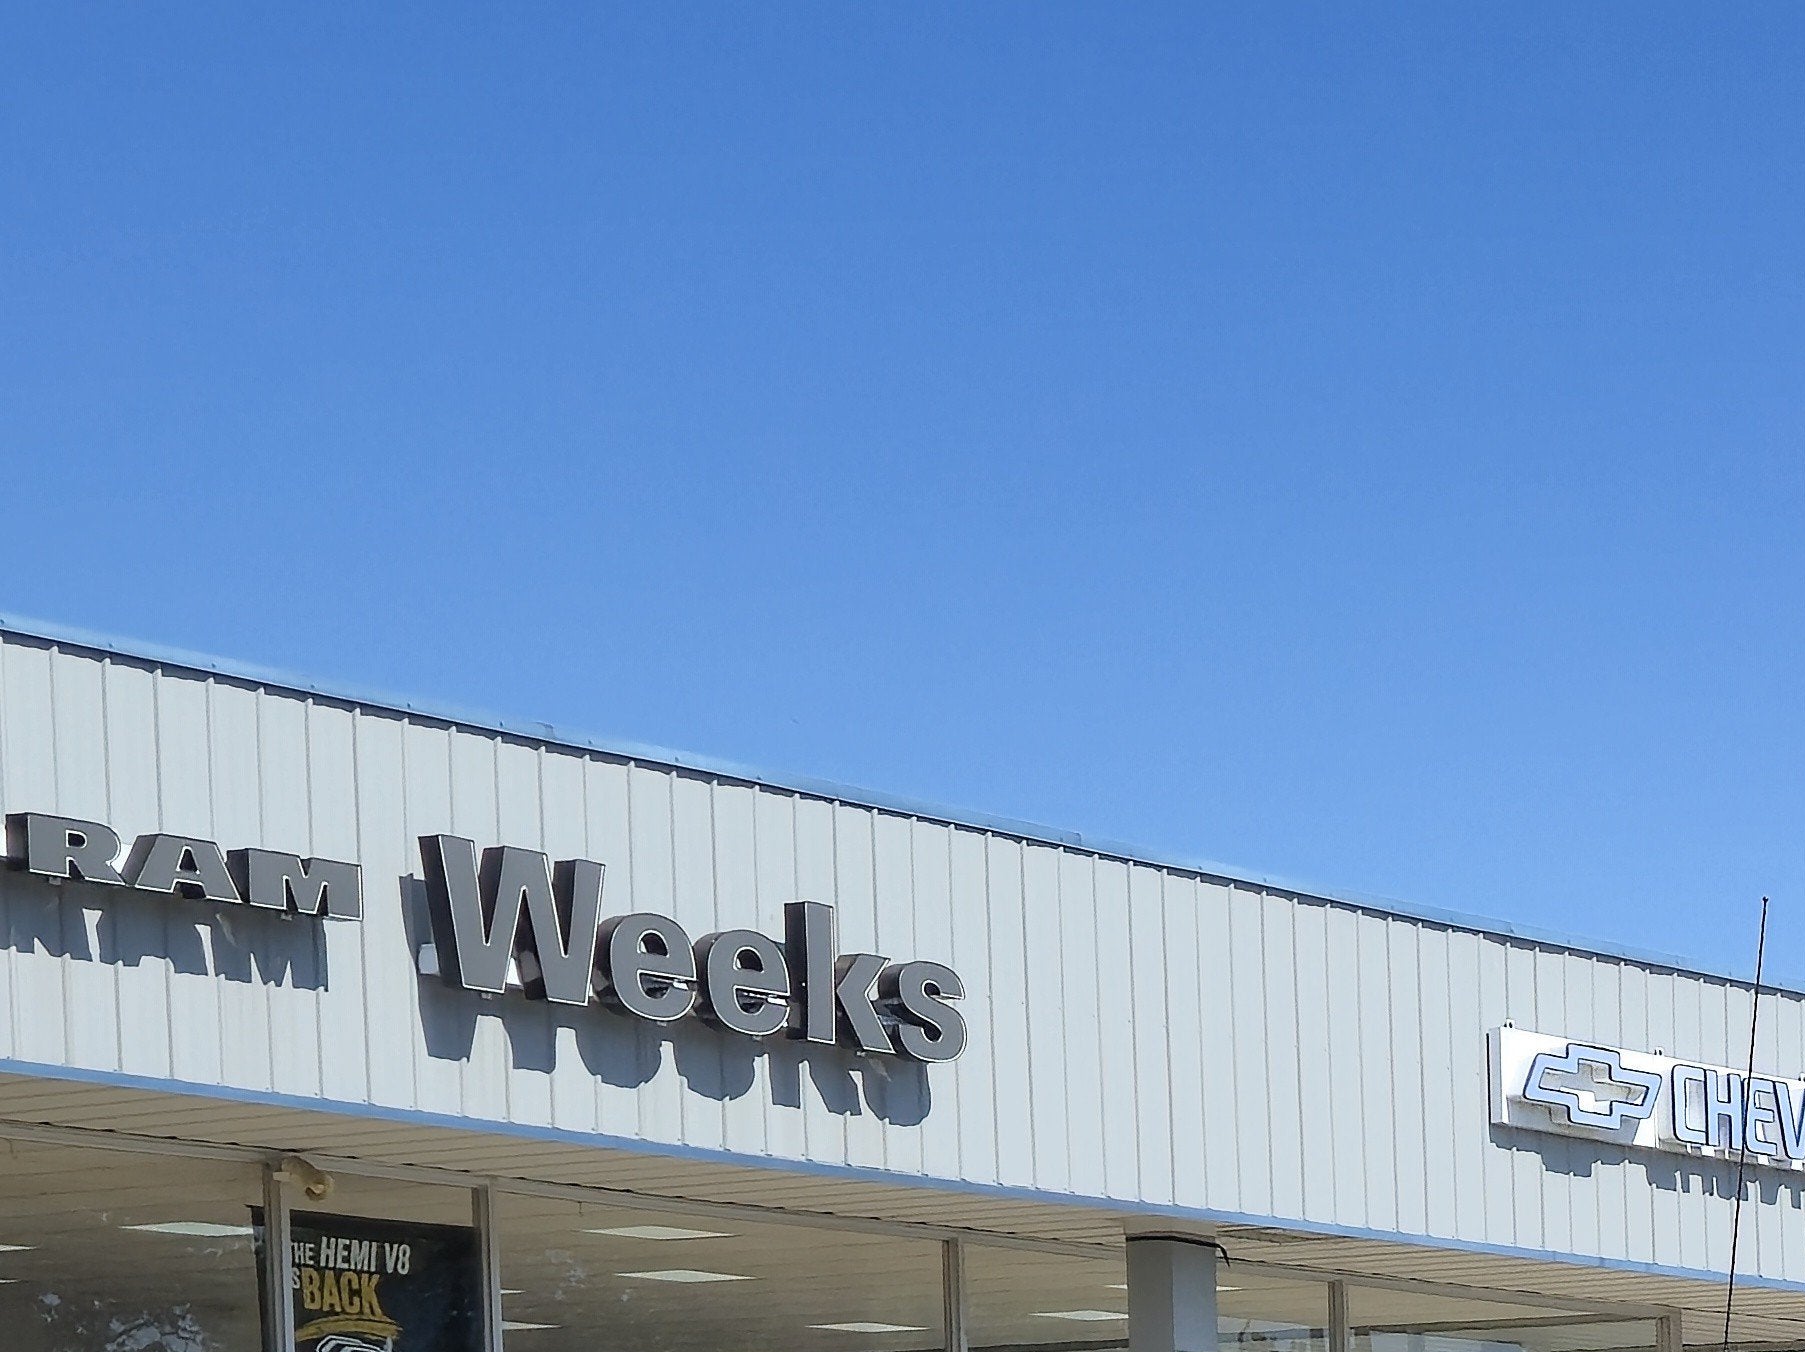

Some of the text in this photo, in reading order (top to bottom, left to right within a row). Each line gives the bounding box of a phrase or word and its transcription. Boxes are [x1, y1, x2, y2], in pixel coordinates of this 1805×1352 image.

[18, 811, 363, 921] RAM
[422, 834, 967, 1063] Weeks
[292, 1236, 411, 1275] HE HEMI V8
[302, 1267, 385, 1319] BACK
